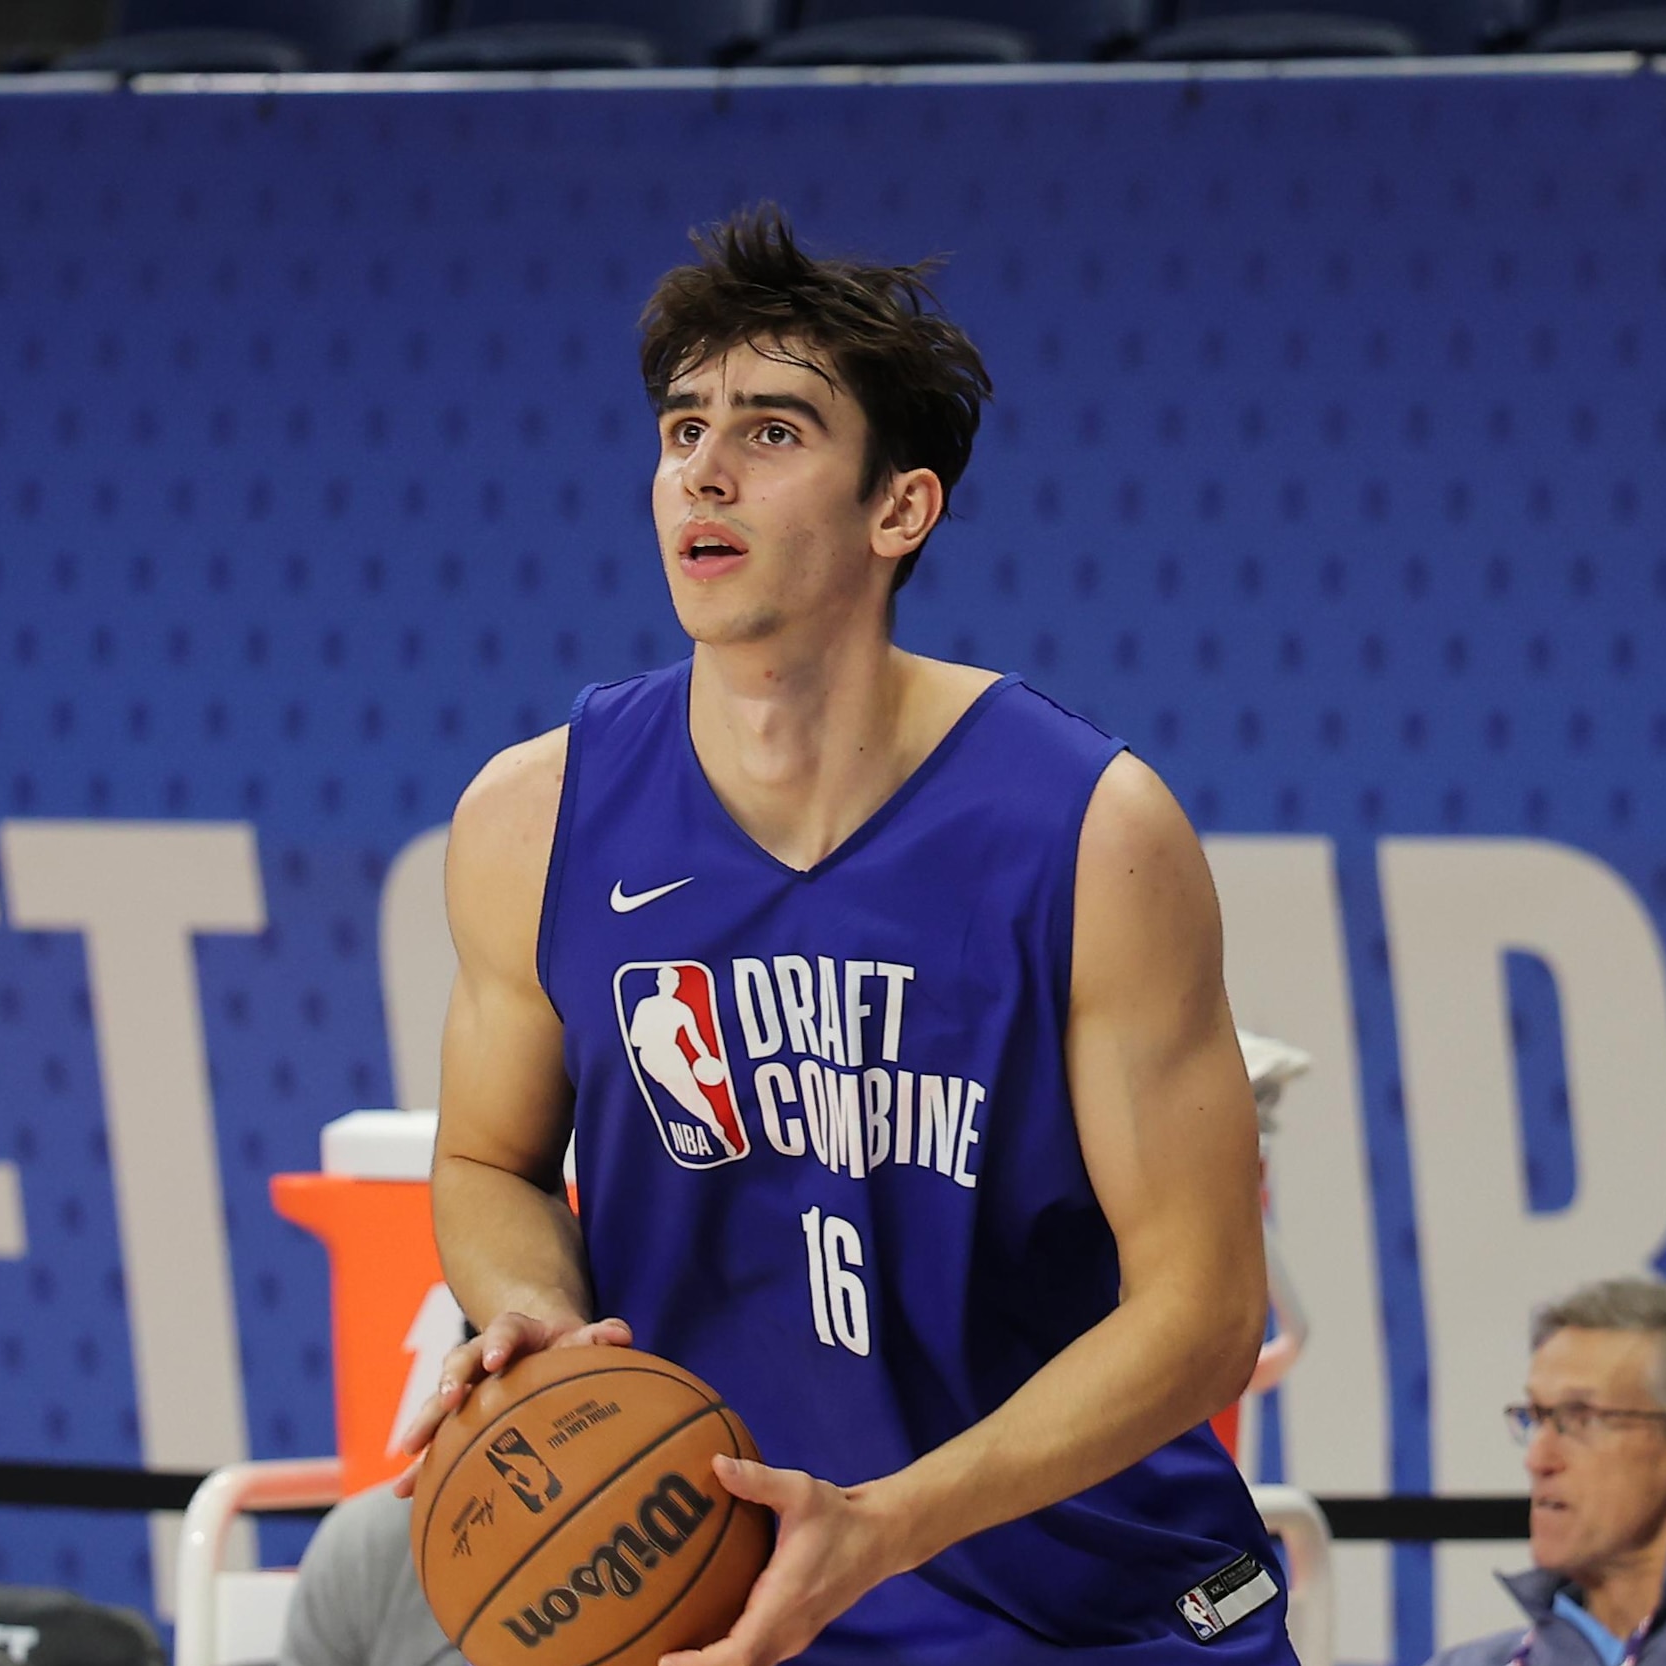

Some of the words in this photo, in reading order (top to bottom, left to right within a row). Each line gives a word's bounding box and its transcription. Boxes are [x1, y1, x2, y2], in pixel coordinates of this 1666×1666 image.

[732, 954, 915, 1067] DRAFT
[668, 1120, 714, 1157] NBA
[754, 1060, 986, 1188] COMBINE
[801, 1206, 870, 1357] 16
[500, 1472, 716, 1649] Wilson
